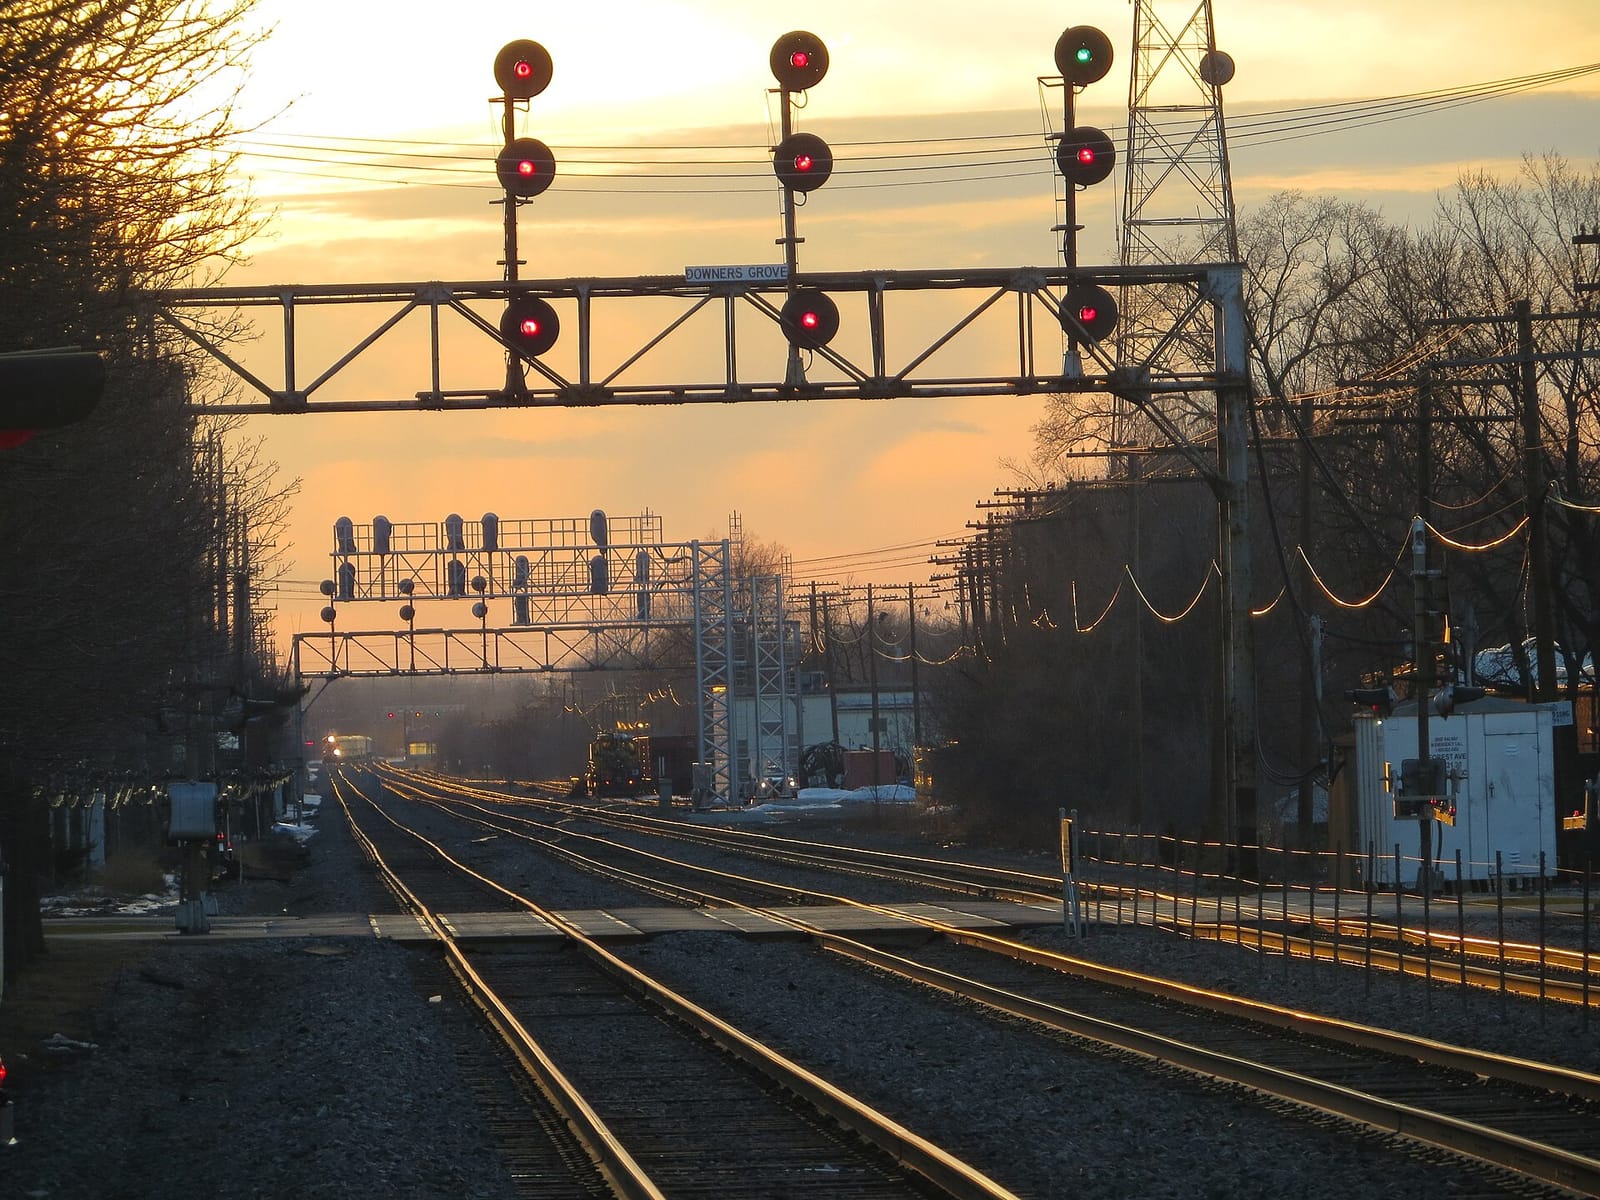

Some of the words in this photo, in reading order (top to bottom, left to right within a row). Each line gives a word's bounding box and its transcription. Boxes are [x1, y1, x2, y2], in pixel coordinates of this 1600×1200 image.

[686, 267, 743, 280] DOWNERS
[748, 265, 788, 279] GROVE
[1454, 752, 1467, 760] AVE
